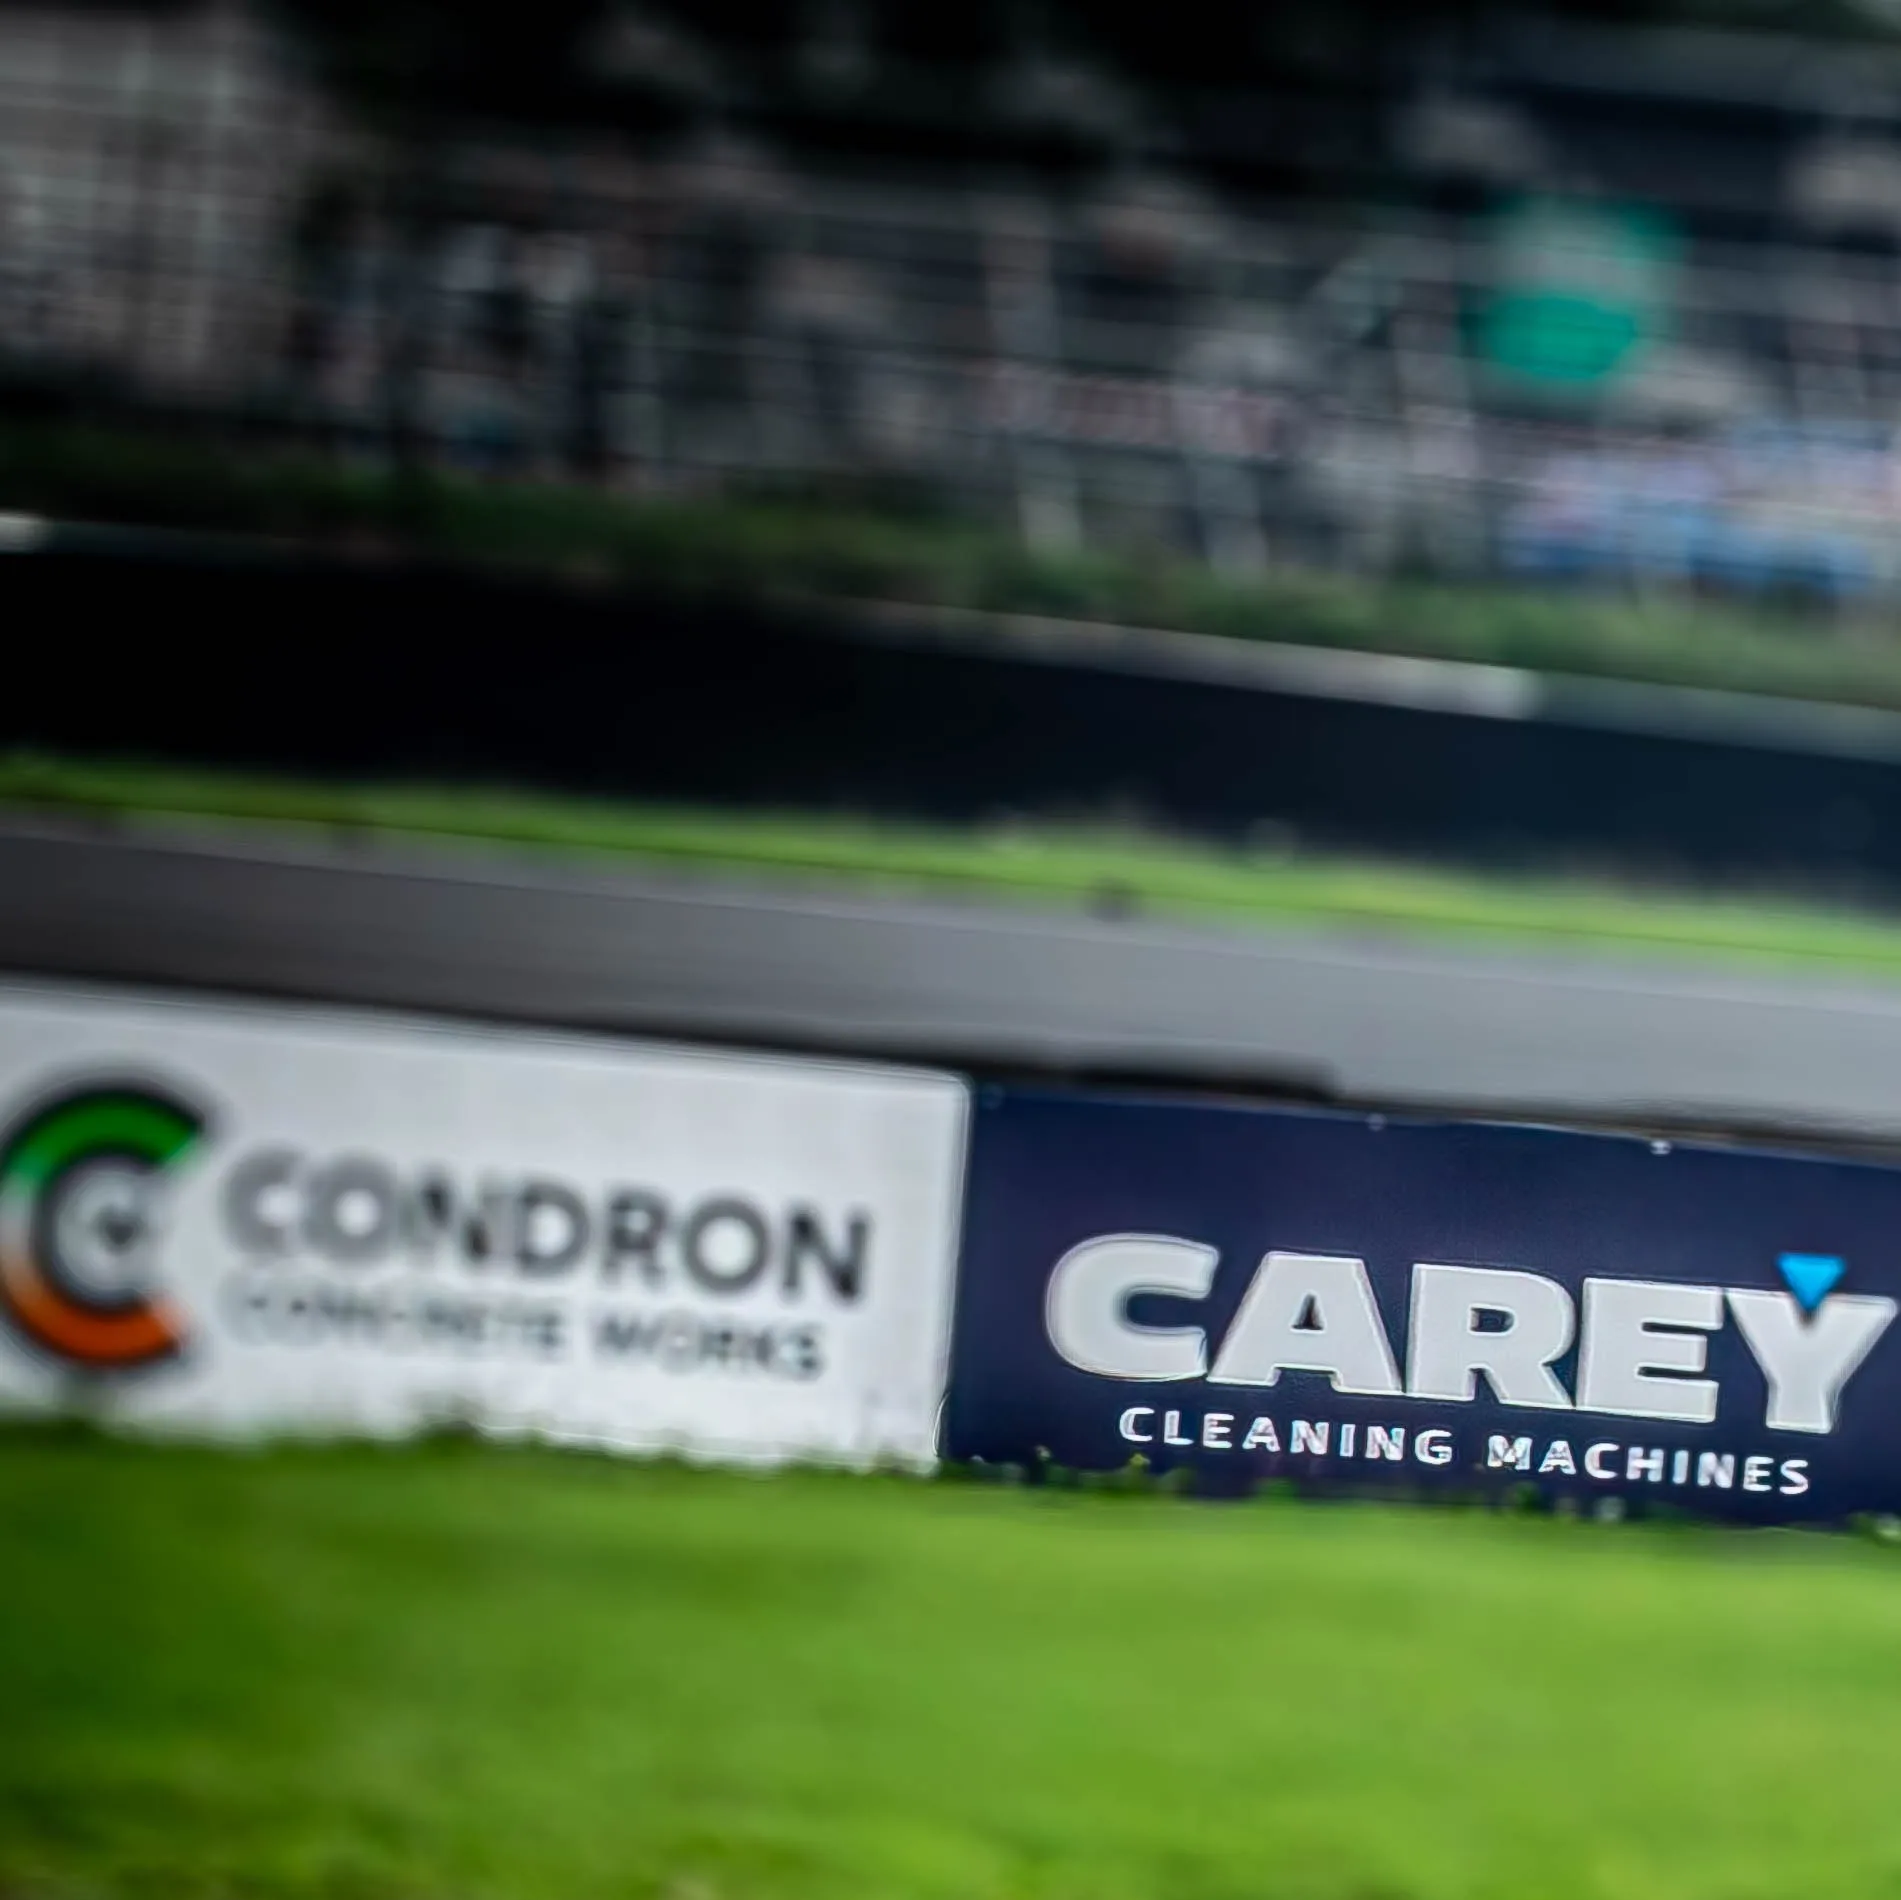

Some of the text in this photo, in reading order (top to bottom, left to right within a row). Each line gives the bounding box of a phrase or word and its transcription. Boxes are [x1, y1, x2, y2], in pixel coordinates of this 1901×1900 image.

[222, 1147, 872, 1306] CONDRON
[597, 1308, 826, 1382] WORKS
[1046, 1232, 1900, 1434] CAREY
[1118, 1406, 1812, 1497] CLEANING MACHINES
